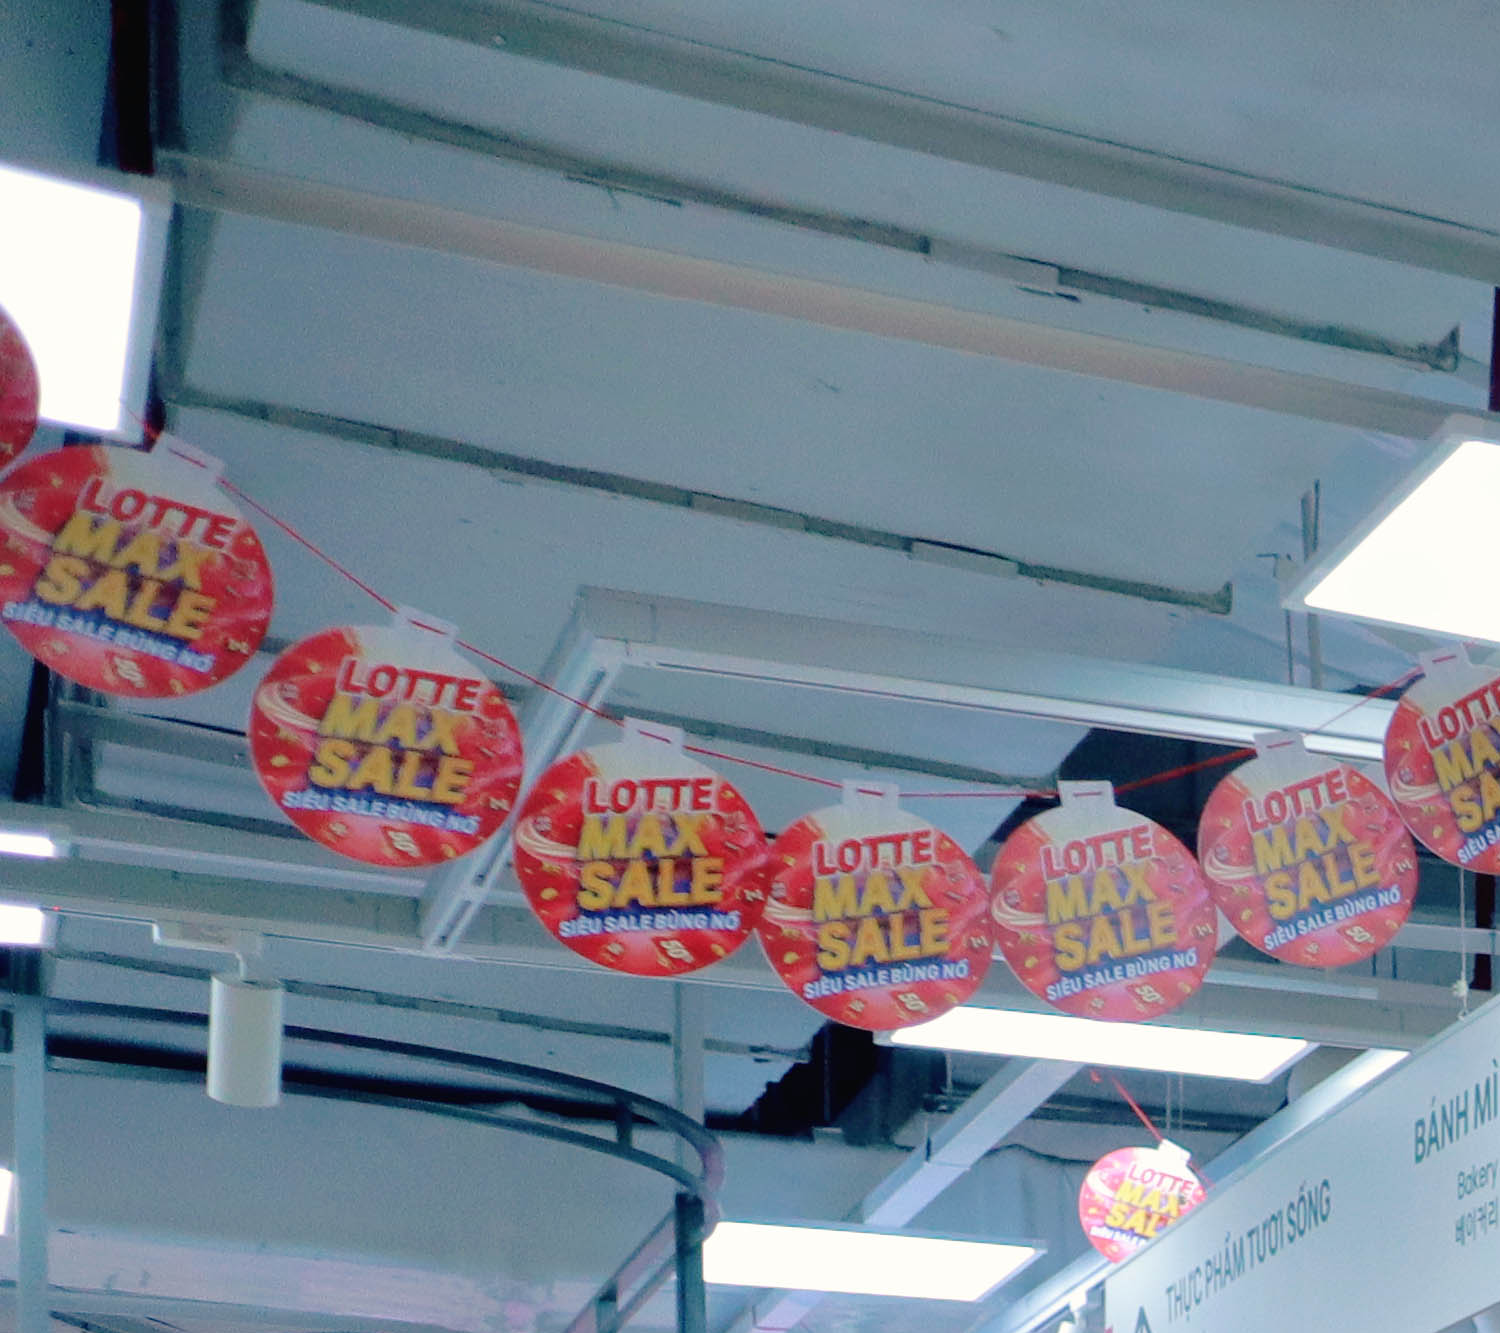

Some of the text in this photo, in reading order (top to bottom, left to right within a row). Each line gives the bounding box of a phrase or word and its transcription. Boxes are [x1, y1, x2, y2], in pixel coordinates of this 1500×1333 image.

[585, 778, 716, 814] LOTTE
[577, 814, 708, 859] MAX
[577, 858, 724, 911] SALE
[1414, 1059, 1498, 1164] BÁNH MÌ
[1457, 1160, 1498, 1199] Bakery
[1455, 1203, 1498, 1246] 베이커리
[1166, 1179, 1331, 1323] THỰC PHẨM TƯƠI SỐNG
